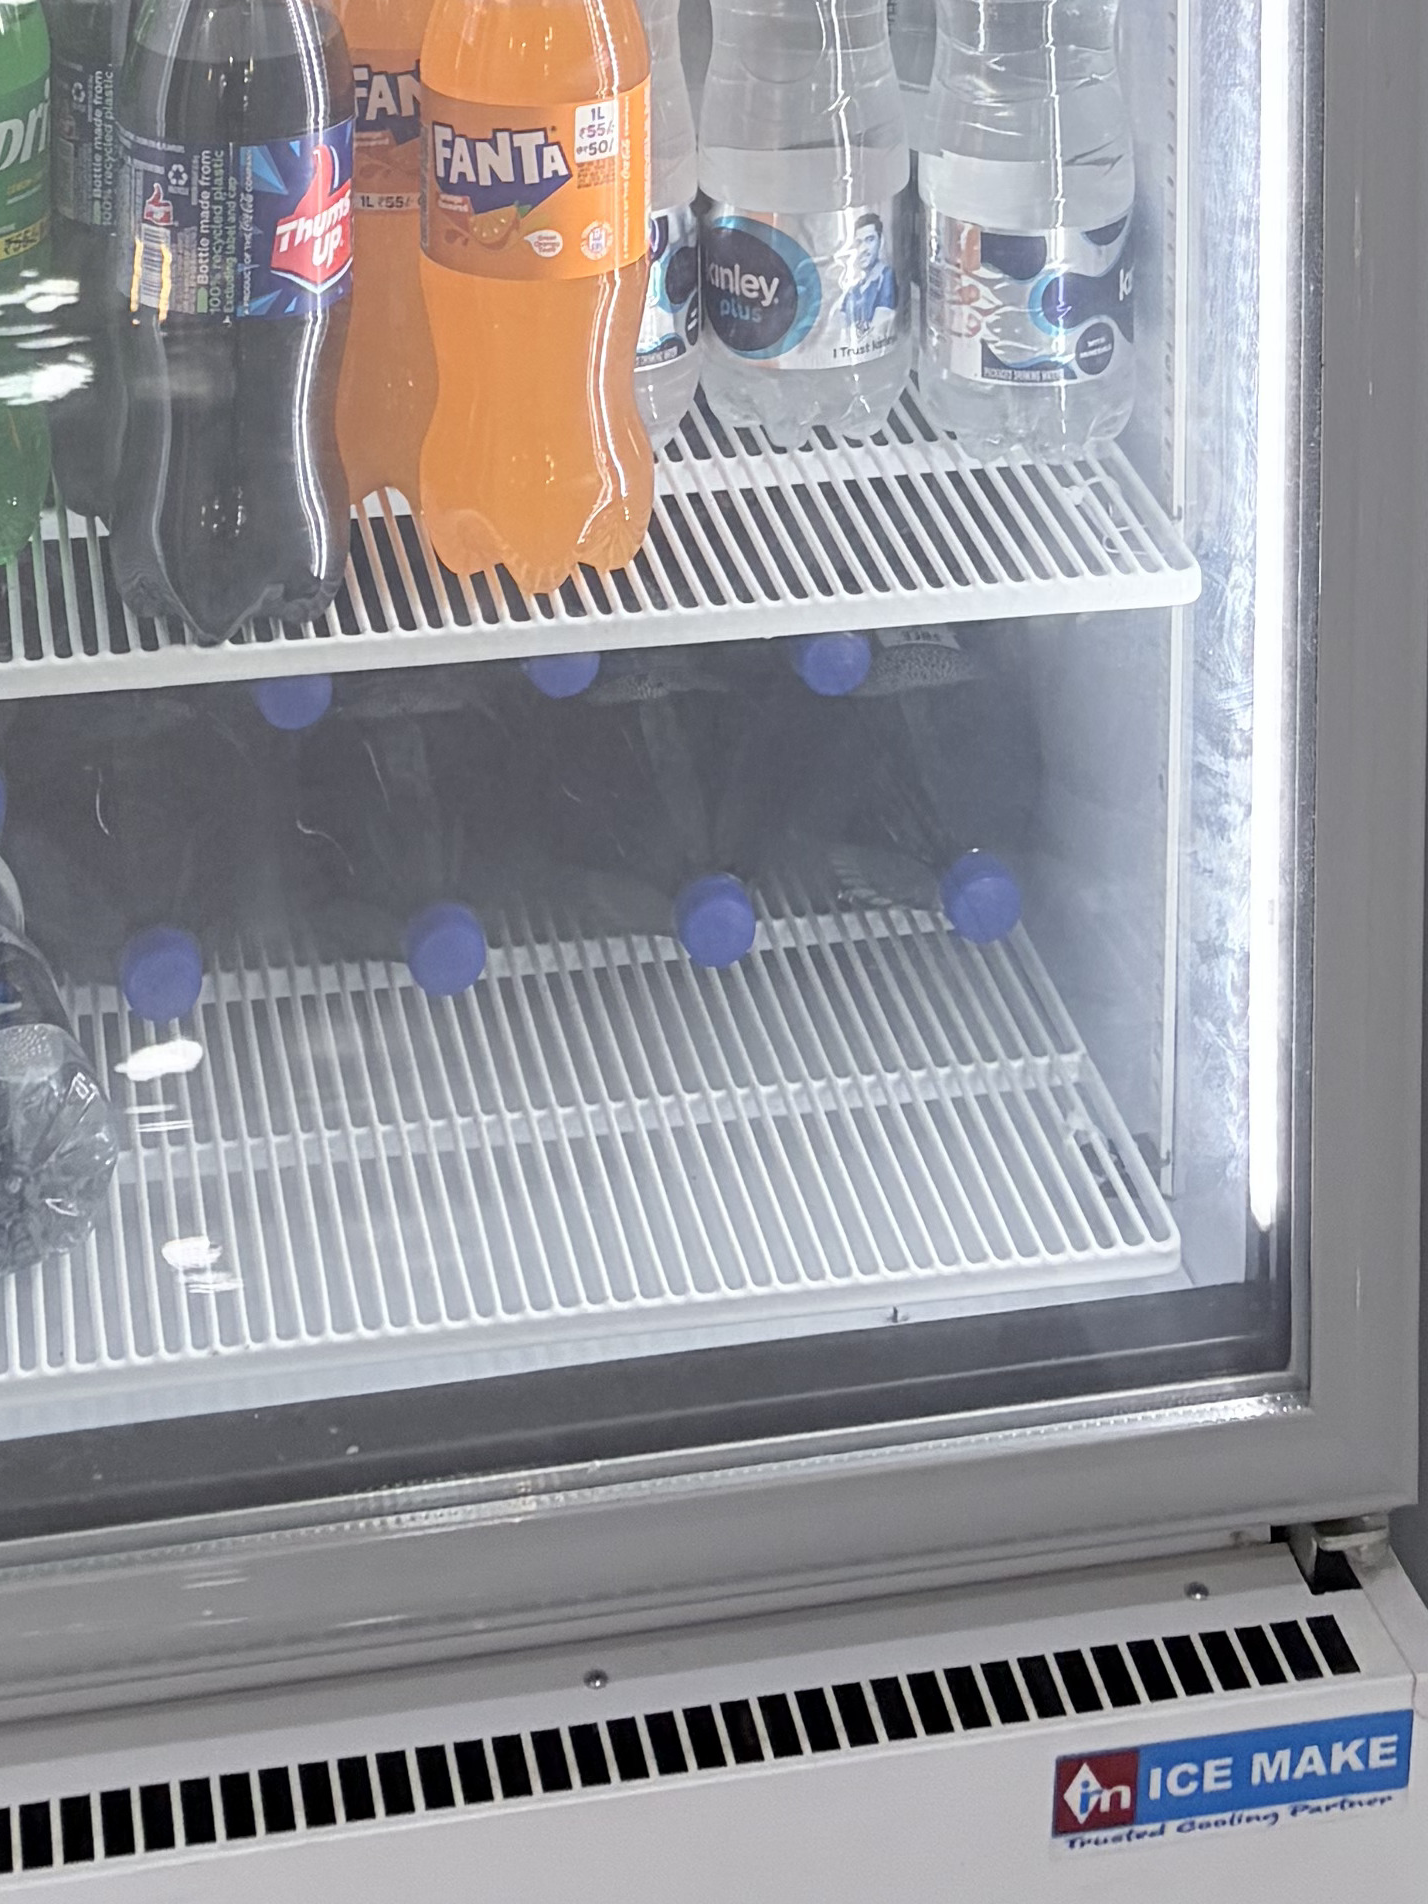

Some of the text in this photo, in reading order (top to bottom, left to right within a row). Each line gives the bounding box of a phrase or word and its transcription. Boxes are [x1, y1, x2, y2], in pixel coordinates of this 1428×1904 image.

[92, 70, 103, 105] from
[353, 67, 421, 121] FAN
[590, 106, 606, 121] 1L
[92, 107, 103, 151] made
[433, 122, 570, 186] FANTA
[197, 150, 211, 285] Bottle made from
[276, 189, 351, 253] Thums
[360, 195, 375, 208] 1L
[209, 150, 224, 313] 100% recycled plastic
[223, 176, 238, 313] Excluding label and cap
[705, 263, 780, 307] kinley
[720, 295, 762, 323] plus
[840, 343, 870, 357] Trust
[1148, 1757, 1233, 1800] ICE
[1251, 1734, 1399, 1787] MAKE
[1065, 1794, 1394, 1849] Trusted Cooling Partner
